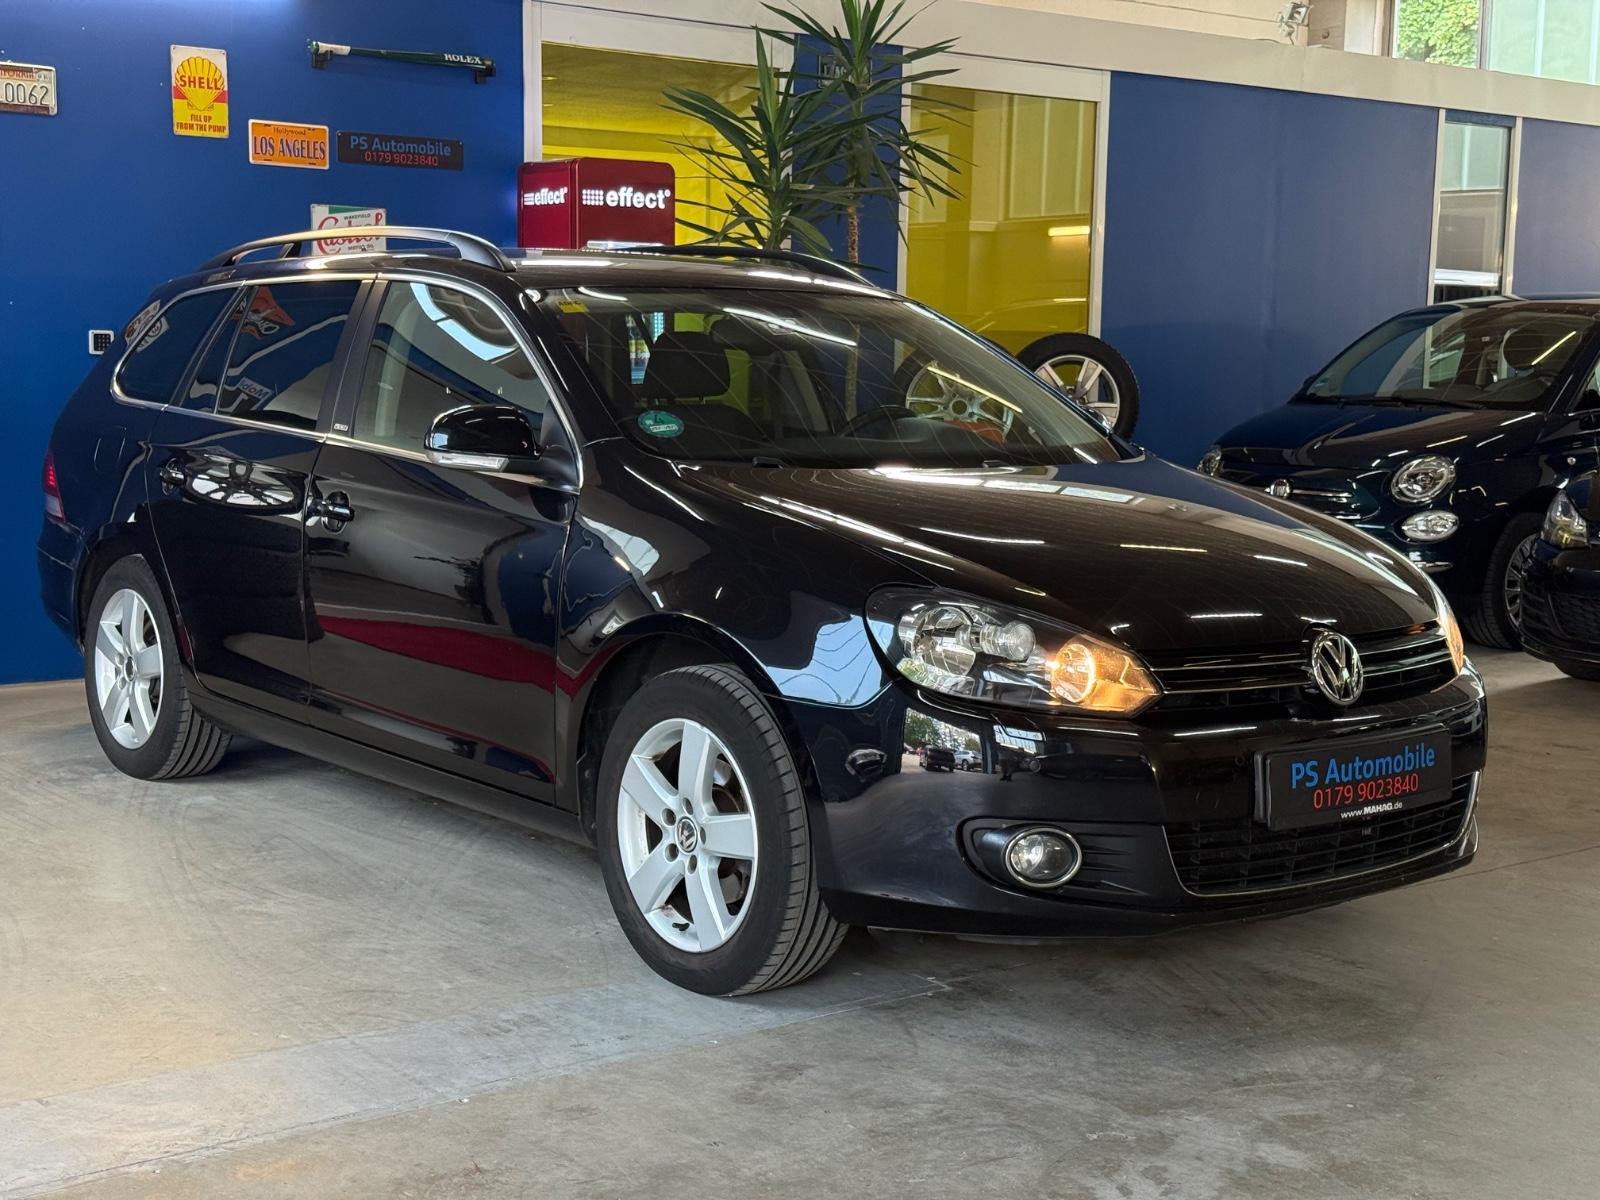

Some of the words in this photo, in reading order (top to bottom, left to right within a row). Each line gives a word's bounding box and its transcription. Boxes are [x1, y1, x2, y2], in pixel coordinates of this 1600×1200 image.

[179, 75, 221, 91] SHELL
[176, 122, 195, 131] FROM
[196, 123, 207, 132] THE
[208, 124, 226, 133] PUMP
[190, 114, 202, 123] FILL
[203, 115, 212, 123] UP
[273, 127, 307, 136] Hollywood
[253, 136, 275, 156] LOS
[278, 138, 326, 160] ANGELES
[350, 135, 368, 149] PS
[372, 137, 451, 156] Automobile
[364, 151, 391, 163] 0179
[393, 154, 439, 166] 9023840
[534, 187, 565, 205] effect
[605, 186, 666, 209] effect
[1291, 760, 1319, 789] PS
[1325, 742, 1435, 785] Automobile
[1313, 785, 1354, 809] 0179
[1357, 773, 1419, 802] 9023840
[1340, 801, 1403, 819] www.MAHAG.de
